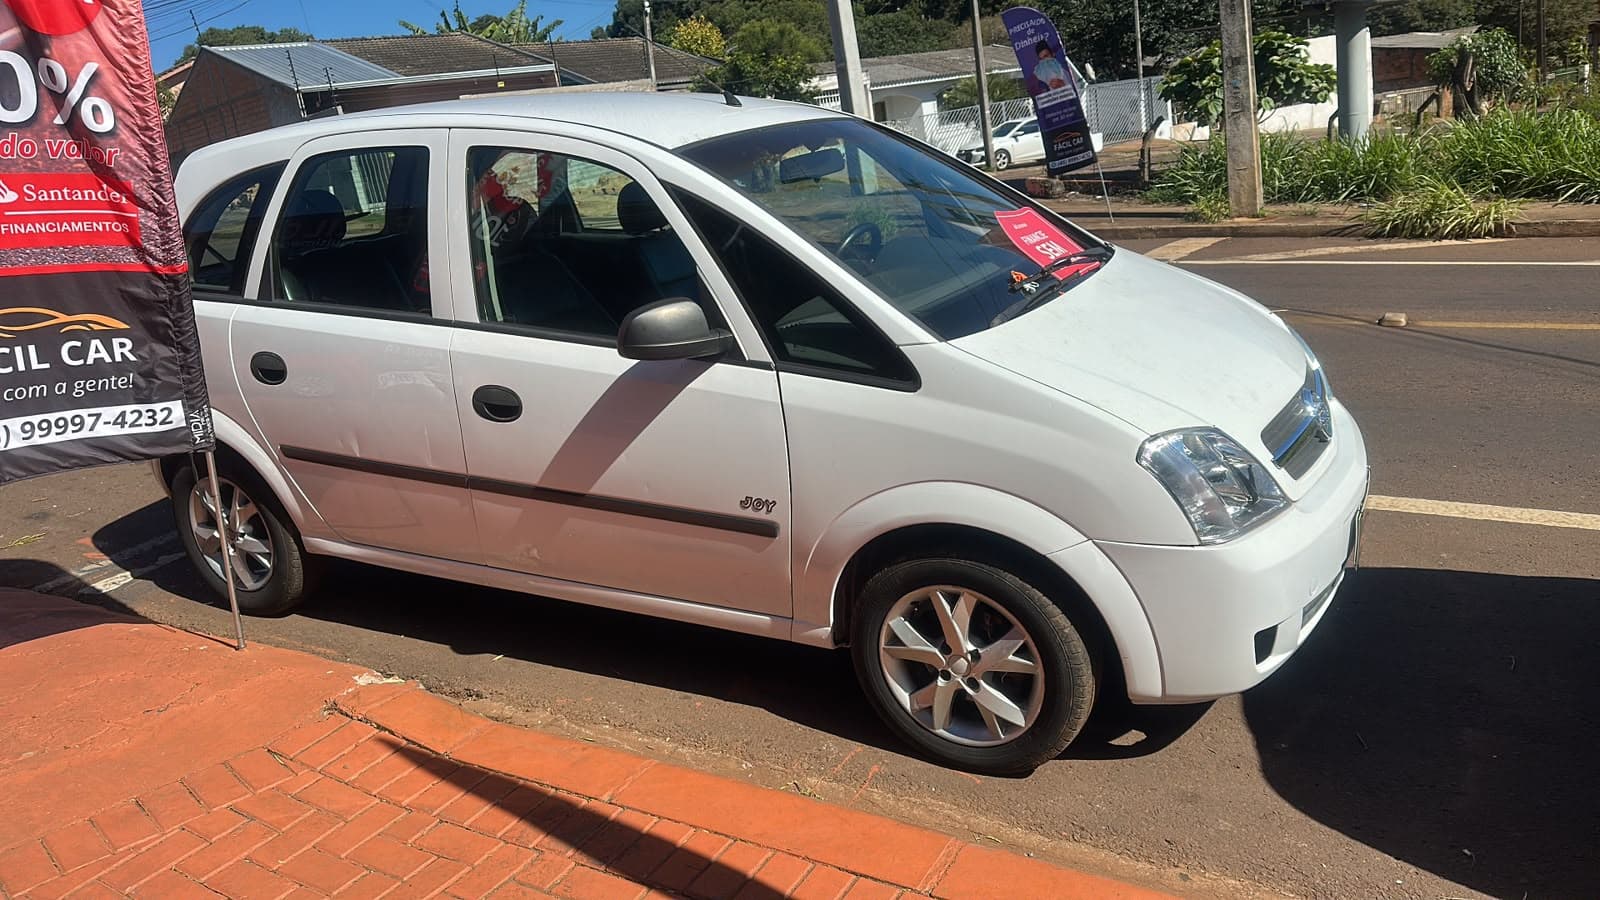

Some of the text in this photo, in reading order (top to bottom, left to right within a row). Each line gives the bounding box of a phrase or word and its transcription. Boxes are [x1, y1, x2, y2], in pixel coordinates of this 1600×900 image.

[0, 132, 120, 168] do valor
[22, 183, 129, 204] Santander
[0, 221, 129, 235] FINANCIAMENTOS
[60, 337, 138, 367] CAR
[3, 373, 135, 402] com a gente!
[20, 406, 174, 441] 99997-4232
[739, 496, 777, 514] JOY
